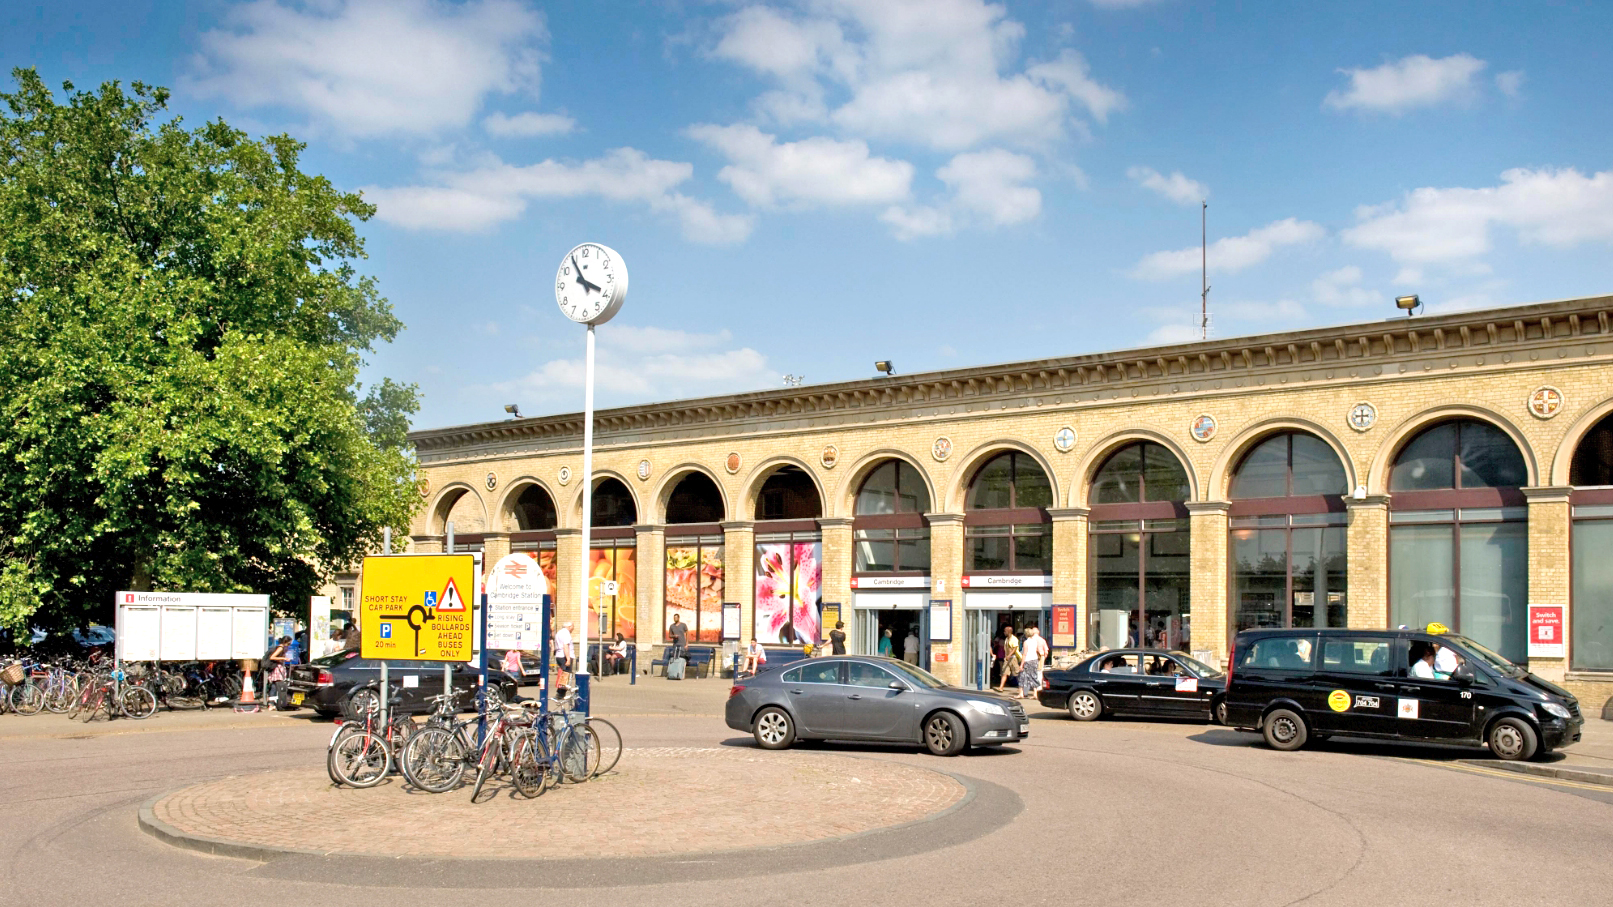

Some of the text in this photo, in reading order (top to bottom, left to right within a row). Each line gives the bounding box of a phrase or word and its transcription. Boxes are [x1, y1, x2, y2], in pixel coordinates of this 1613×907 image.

[582, 248, 589, 258] 12
[602, 260, 609, 270] 2
[563, 266, 570, 276] 10
[606, 274, 612, 283] 3
[559, 282, 565, 291] 9
[602, 289, 608, 299] 4
[563, 296, 568, 305] 8
[571, 305, 577, 315] 7
[595, 301, 600, 311] 5
[582, 308, 588, 317] 6
[873, 578, 904, 586] Cambridge
[987, 577, 1022, 585] Cambridge
[138, 594, 182, 602] Information
[365, 595, 408, 603] SHORT STAY
[438, 614, 464, 622] RISING
[382, 624, 391, 637] P
[431, 623, 470, 631] BOLLARDS
[438, 632, 463, 640] AHEAD
[438, 641, 463, 649] BUSES
[1460, 691, 1472, 699] 170
